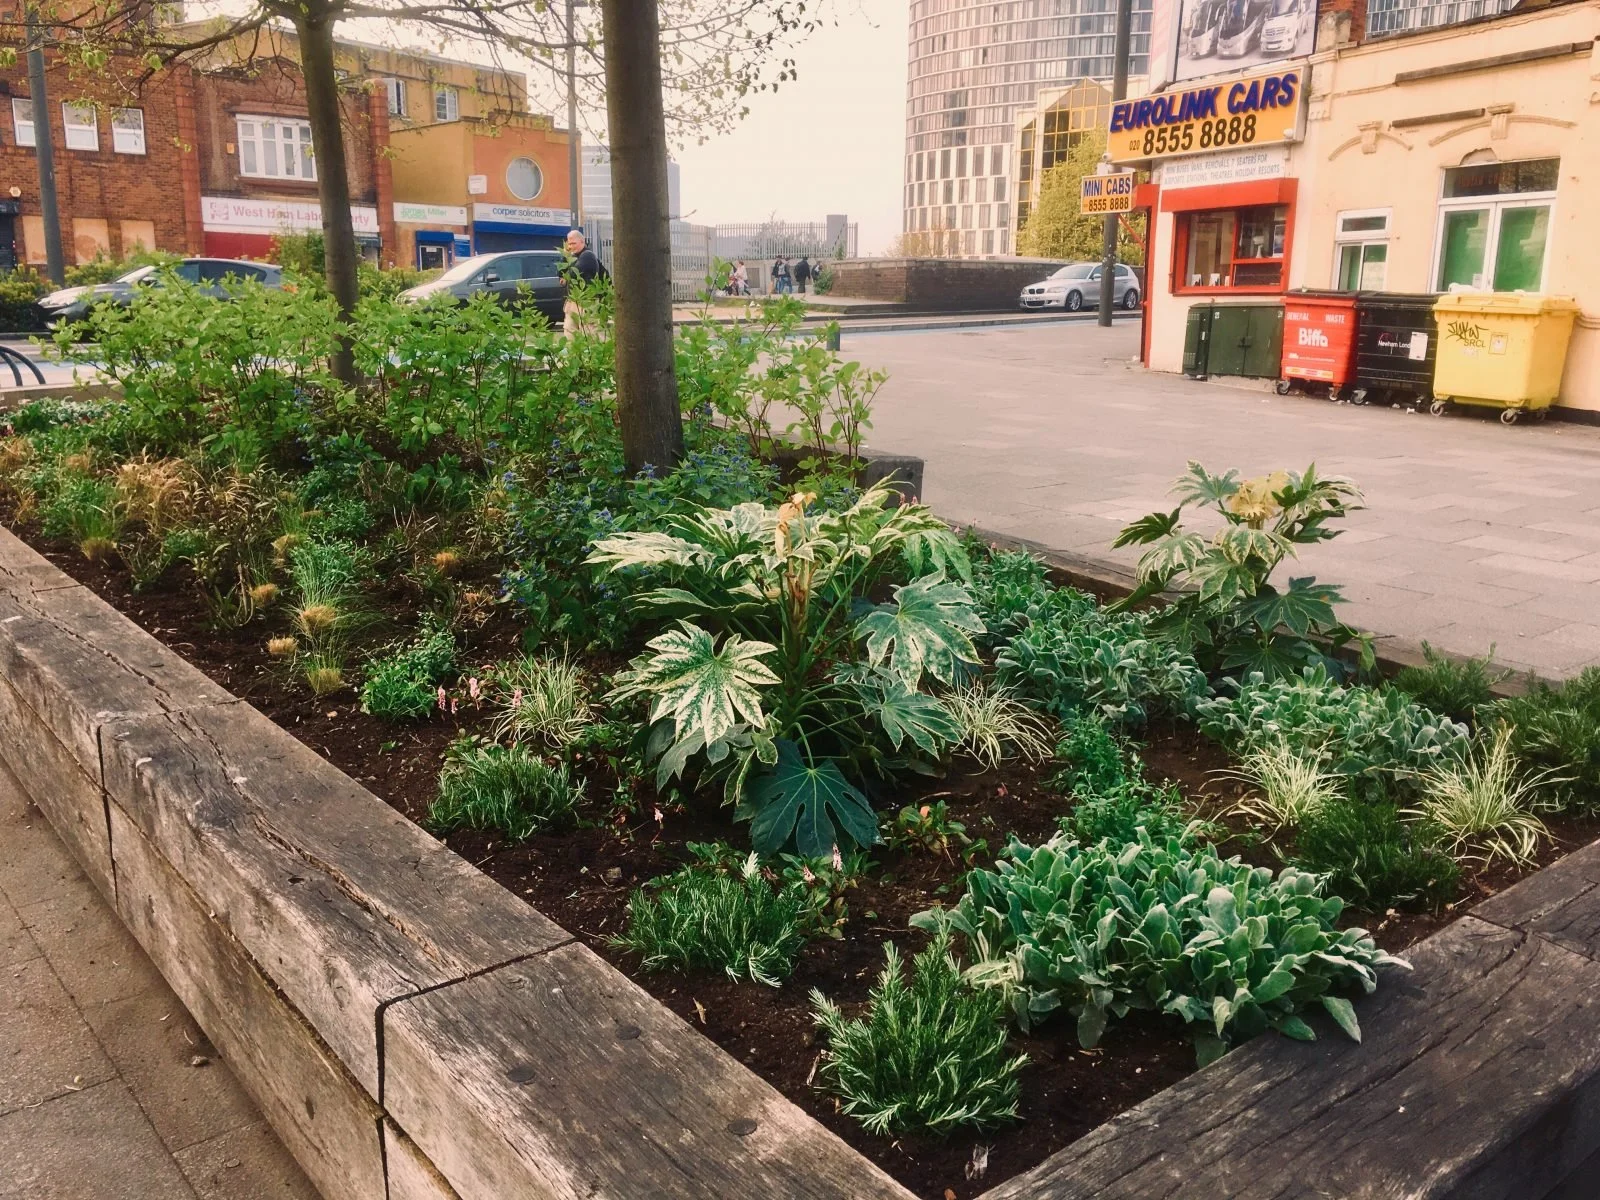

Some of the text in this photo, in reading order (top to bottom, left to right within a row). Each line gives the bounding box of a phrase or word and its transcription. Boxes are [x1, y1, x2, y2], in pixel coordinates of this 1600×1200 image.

[1110, 73, 1299, 133] EUROLINK CARS
[1129, 114, 1257, 155] 020 8555 8888
[1084, 177, 1131, 197] MINI CABS
[1088, 197, 1129, 212] 8555 8888
[233, 205, 264, 218] West
[297, 209, 322, 221] Labo
[492, 207, 517, 216] corper
[518, 208, 551, 218] solicitors
[1325, 314, 1345, 324] WASTE
[1299, 327, 1328, 347] Biffa
[1378, 340, 1398, 348] Newham
[1464, 339, 1486, 347] SRCL
